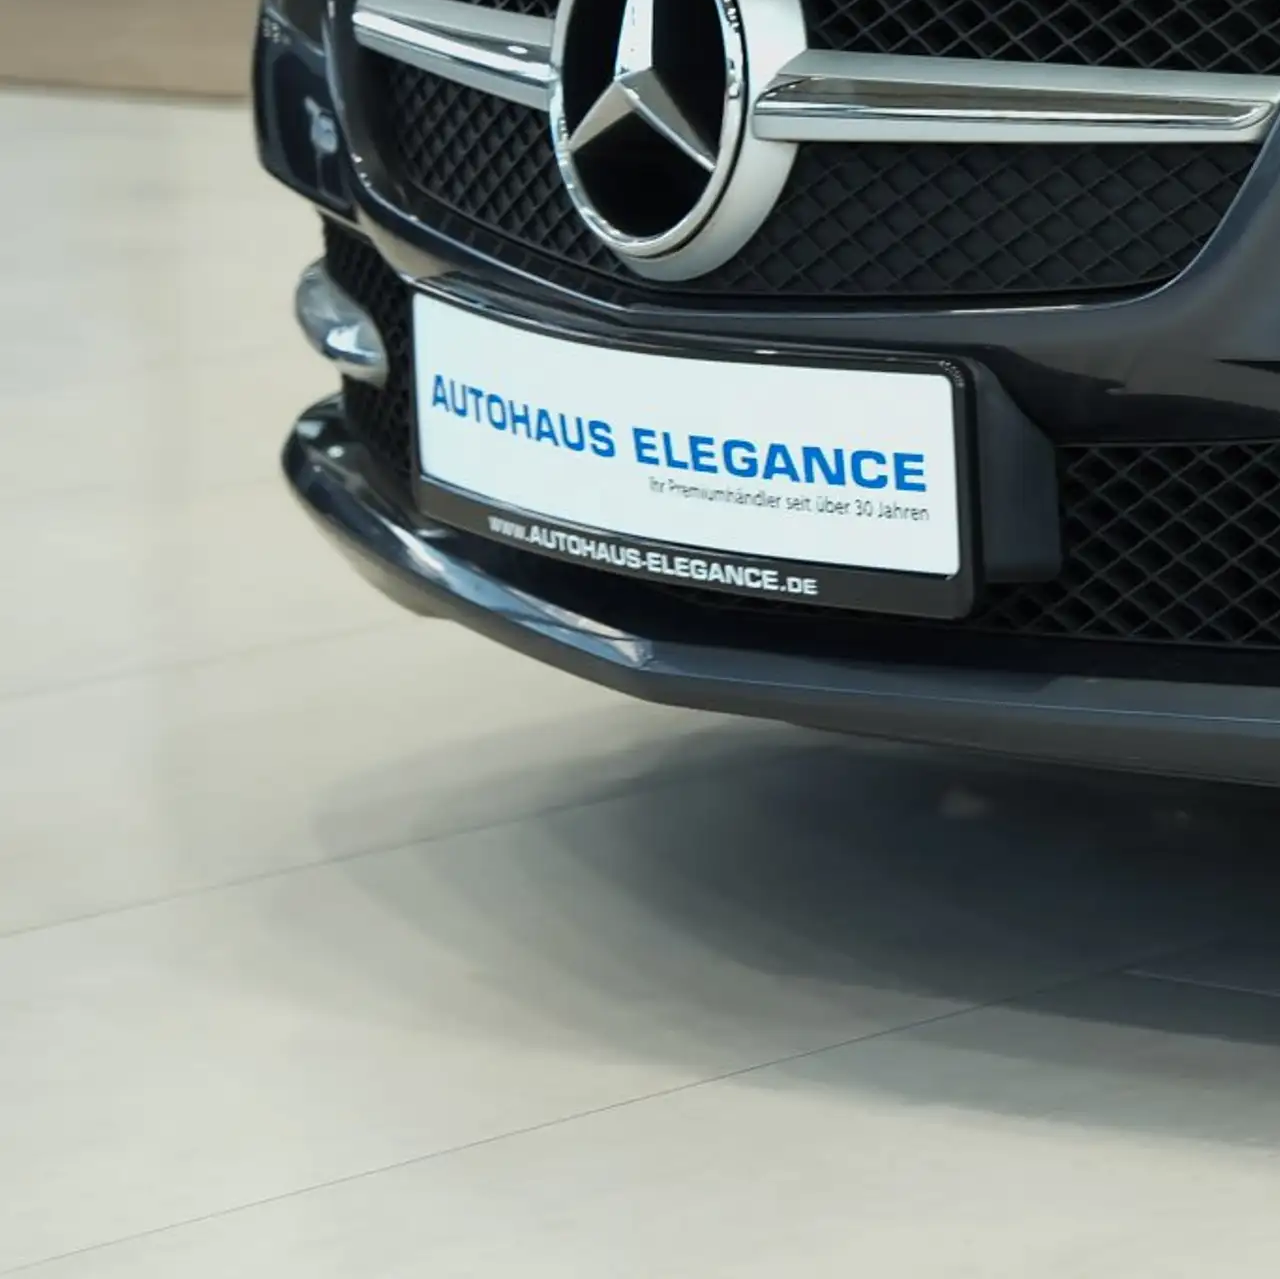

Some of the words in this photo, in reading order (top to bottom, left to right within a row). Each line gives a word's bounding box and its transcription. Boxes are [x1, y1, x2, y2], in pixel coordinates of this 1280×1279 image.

[431, 373, 617, 459] AUTOHAUS
[630, 426, 929, 493] ELEGANCE
[649, 476, 666, 493] Ihr
[668, 478, 782, 509] Premiumhändler
[786, 494, 811, 512] seit
[815, 495, 850, 516] über
[854, 498, 873, 518] 30
[877, 502, 930, 522] Jahren
[488, 516, 819, 595] www.AUTOHAUS-ELEGANCE.DE
